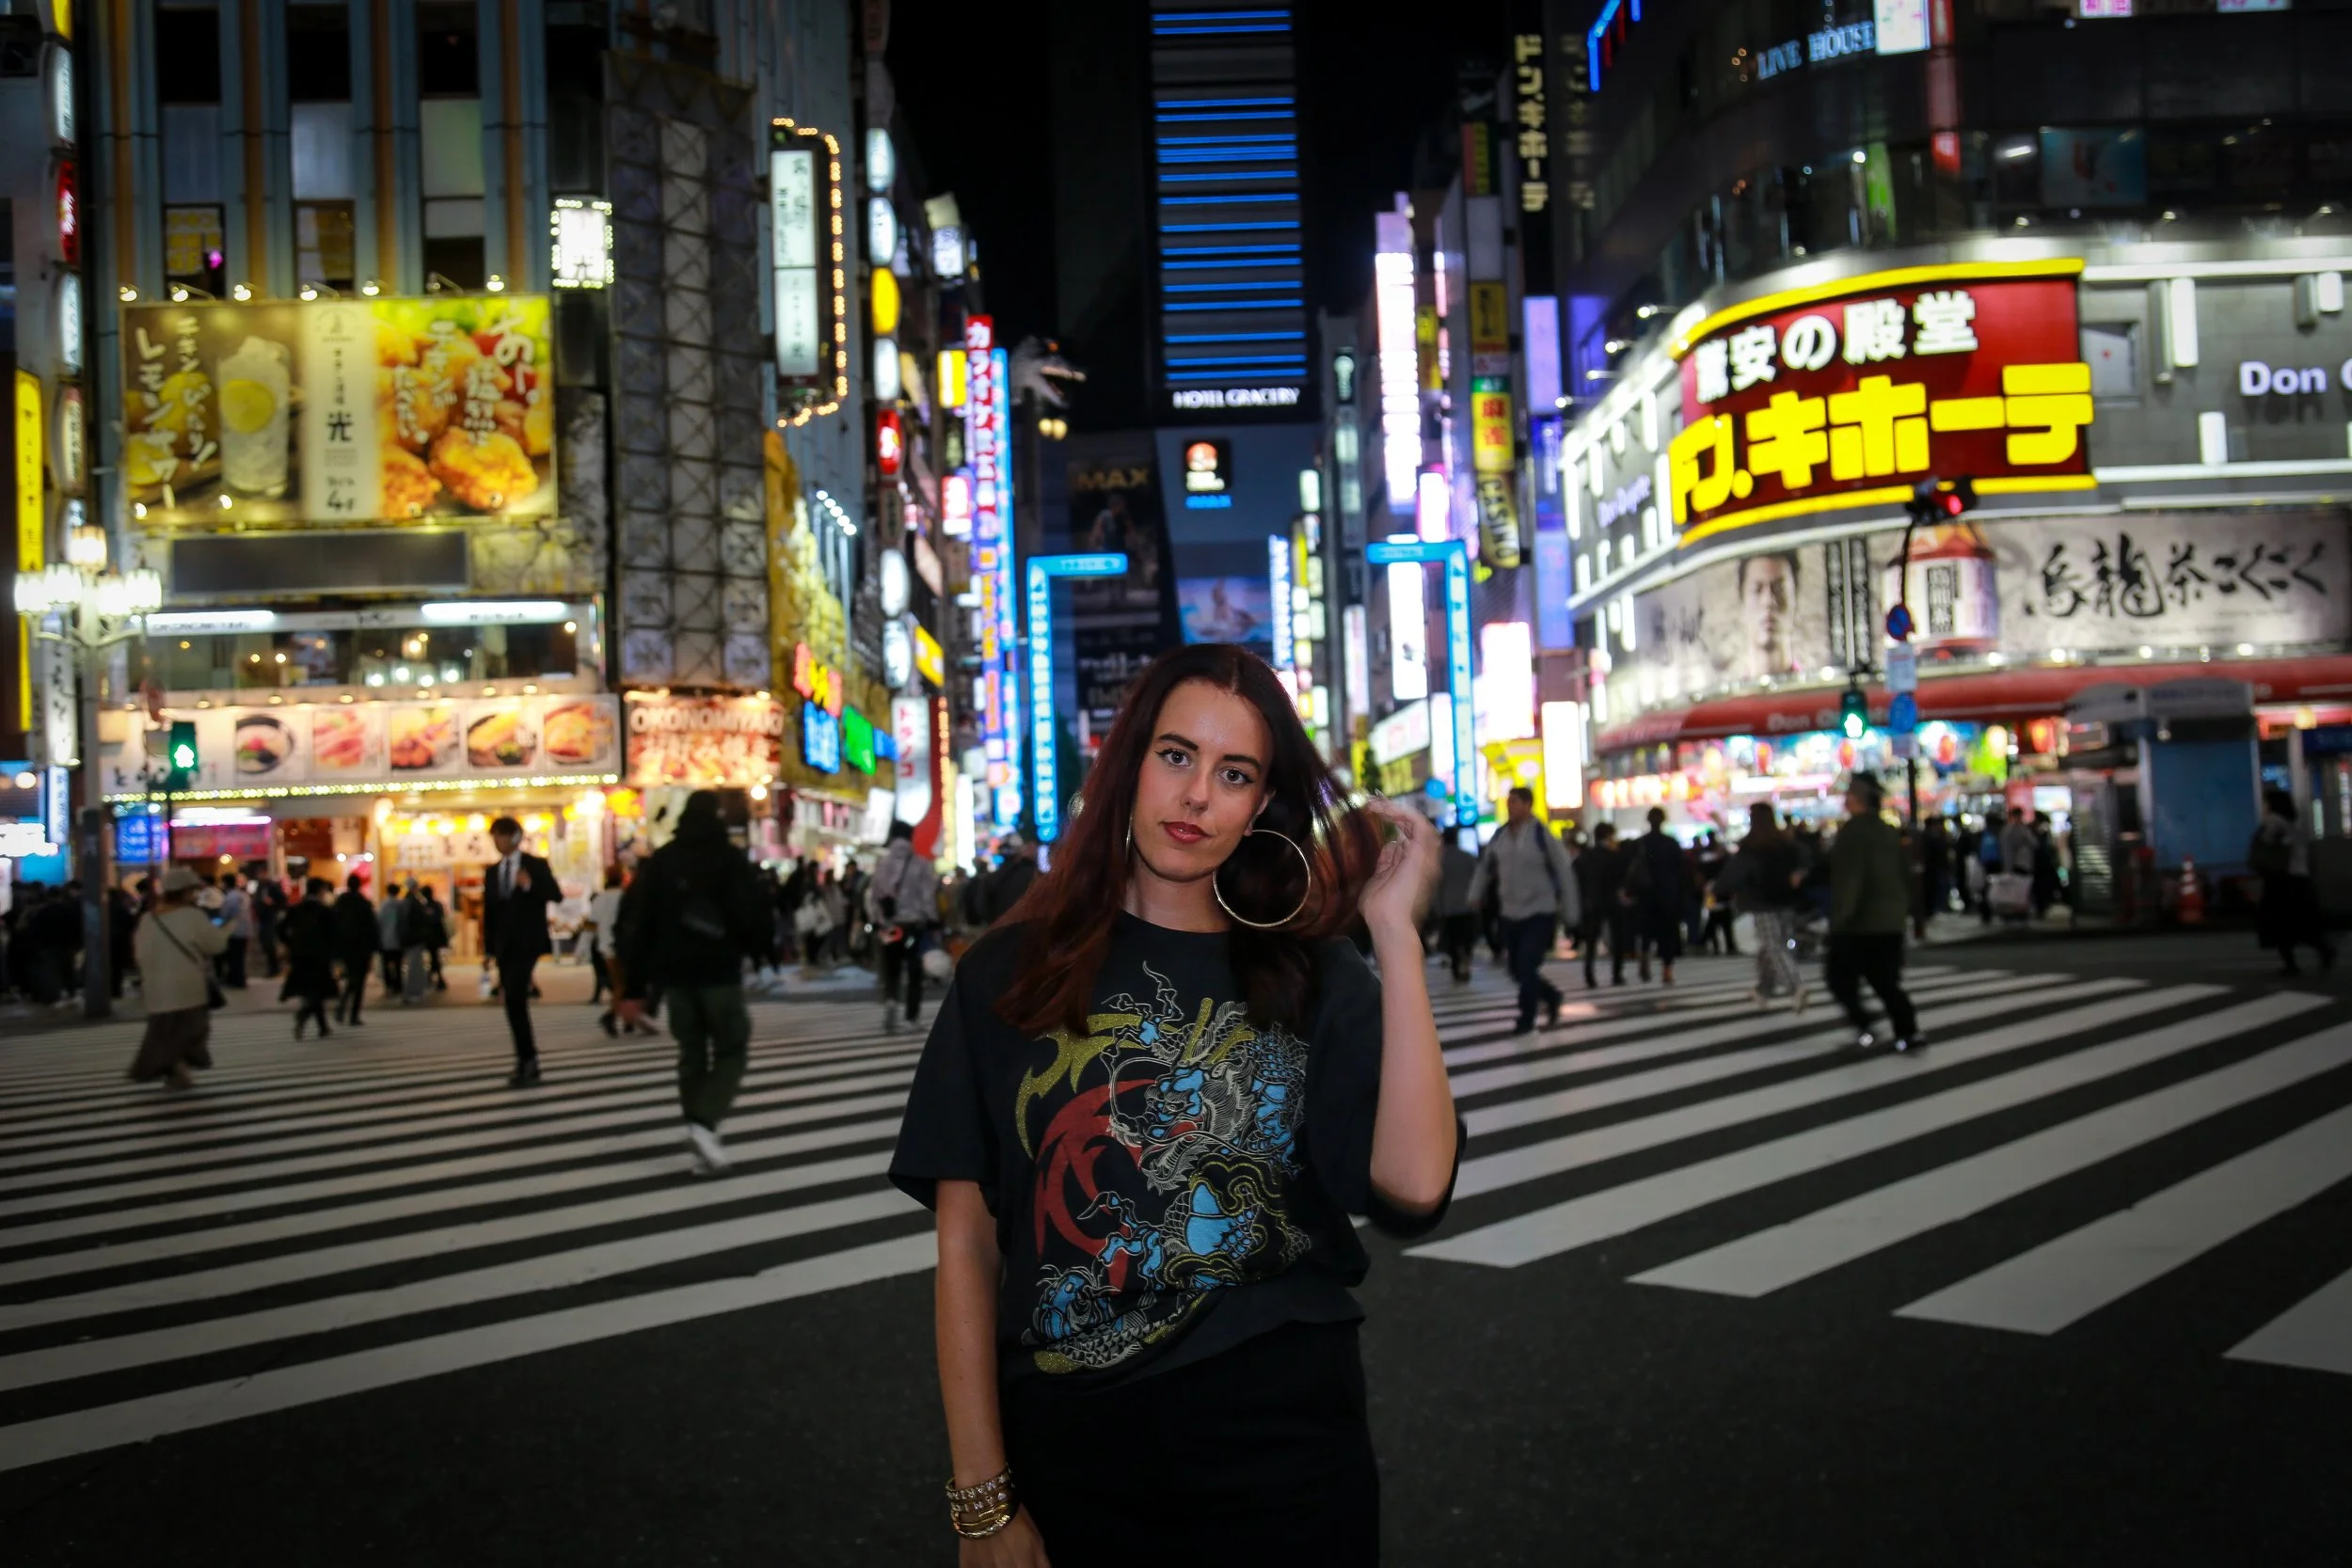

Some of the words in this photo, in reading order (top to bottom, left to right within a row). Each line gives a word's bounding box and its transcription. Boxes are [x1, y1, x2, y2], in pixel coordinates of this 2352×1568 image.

[1756, 40, 1802, 80] LIVE
[1694, 290, 1979, 404] 驚安の殿堂
[2239, 360, 2328, 395] Don
[1172, 389, 1225, 409] HOTEL
[1225, 387, 1301, 407] GRACERY
[326, 410, 355, 443] 光
